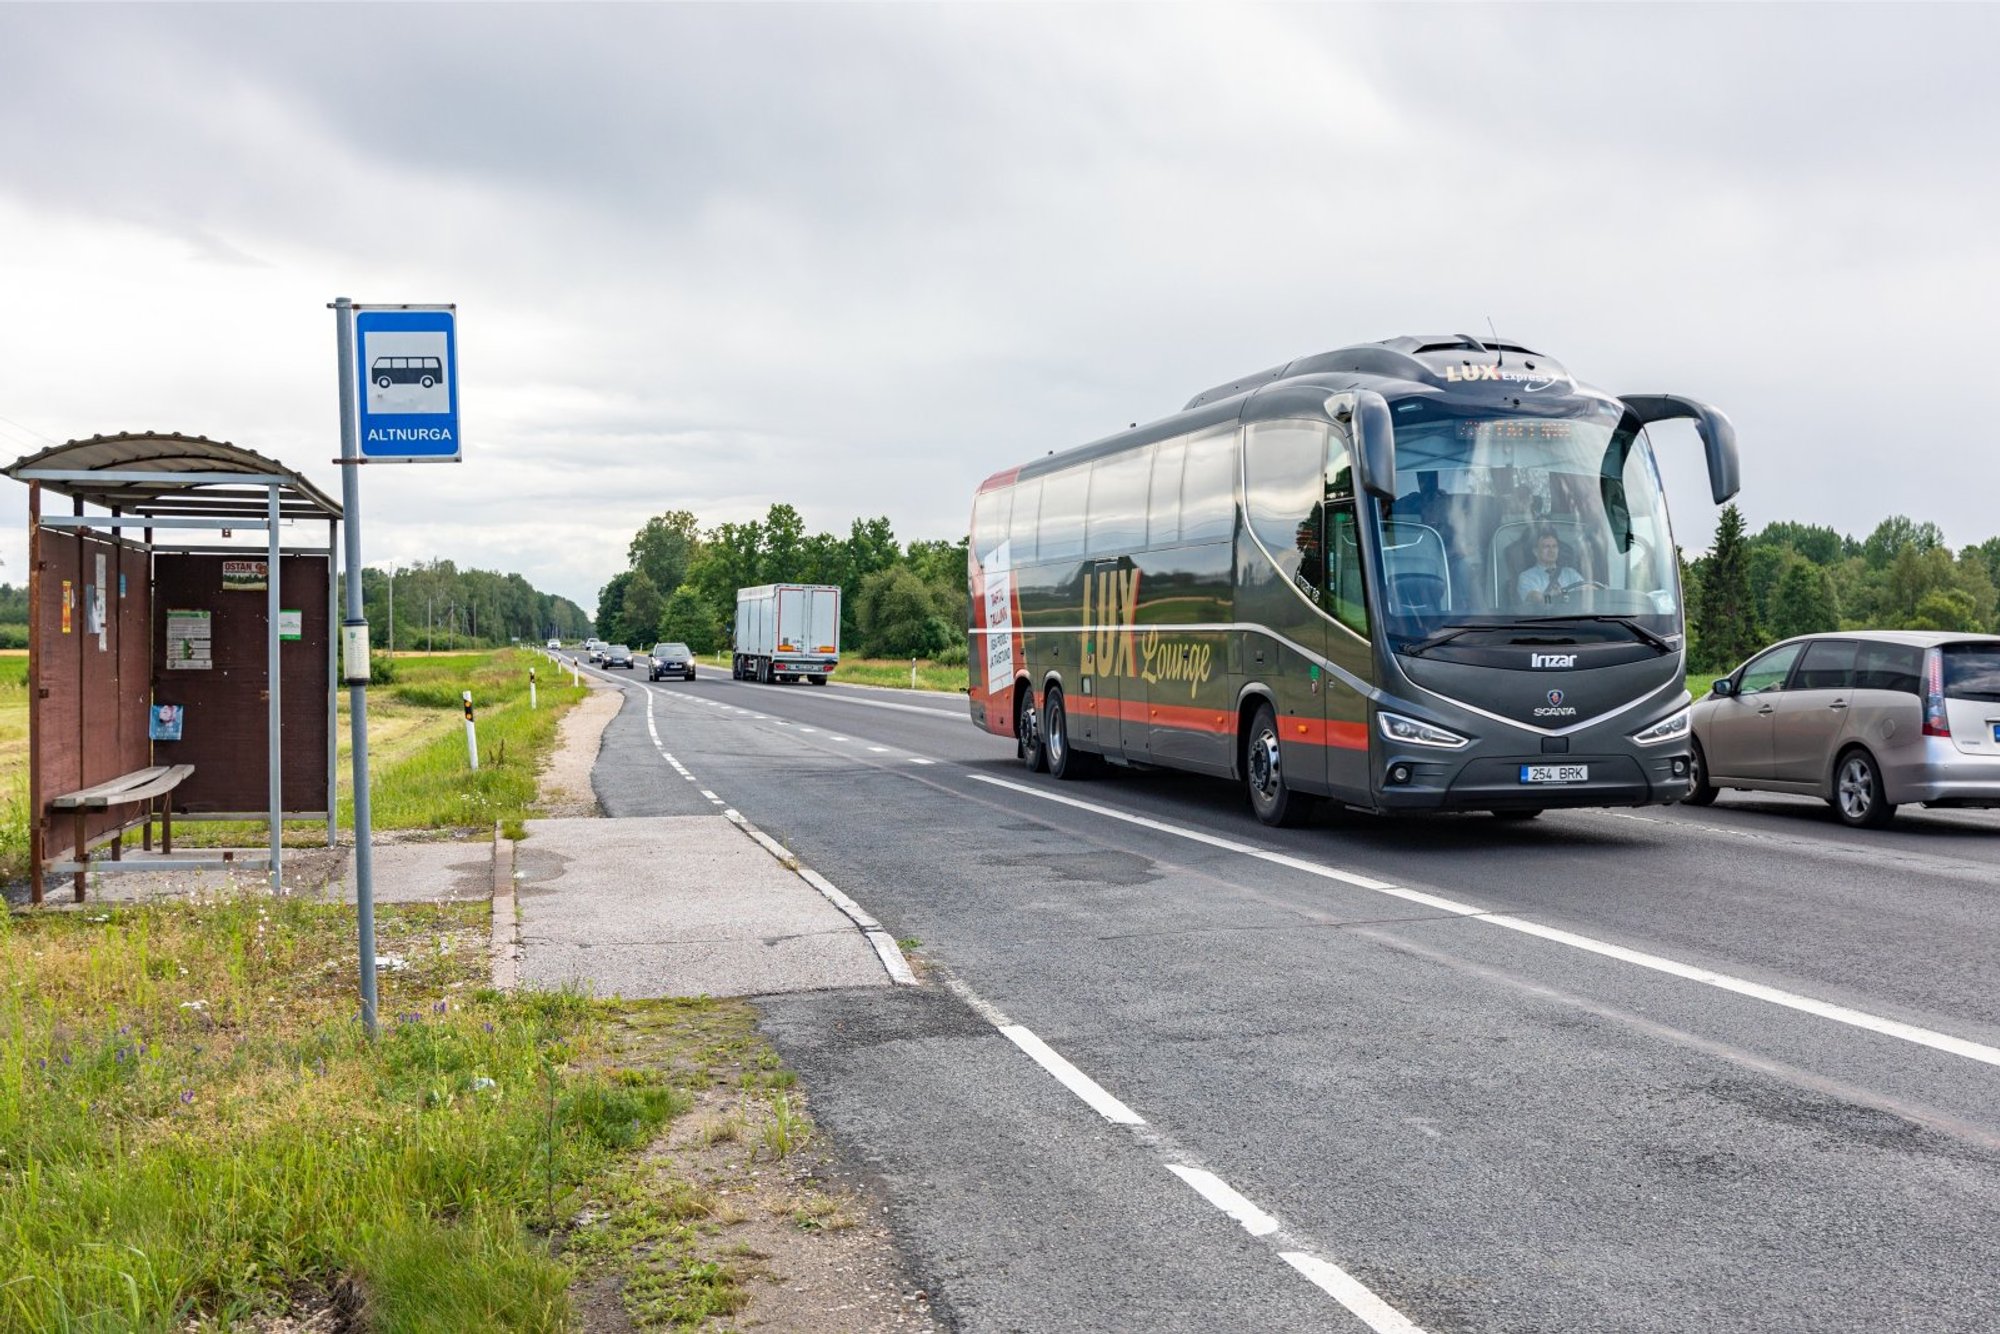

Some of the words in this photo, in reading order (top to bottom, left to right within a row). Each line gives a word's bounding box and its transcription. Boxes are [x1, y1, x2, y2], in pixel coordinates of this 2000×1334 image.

[1446, 364, 1501, 382] LUX
[1502, 371, 1550, 383] Express
[368, 428, 452, 440] ALTNURGA
[225, 562, 252, 570] OSTAN
[1080, 567, 1142, 677] LUX
[1141, 624, 1212, 699] Lounge
[1531, 653, 1577, 668] Irizar
[1533, 707, 1577, 717] SCANIA
[1532, 768, 1552, 780] 254
[1559, 767, 1583, 779] BRK
